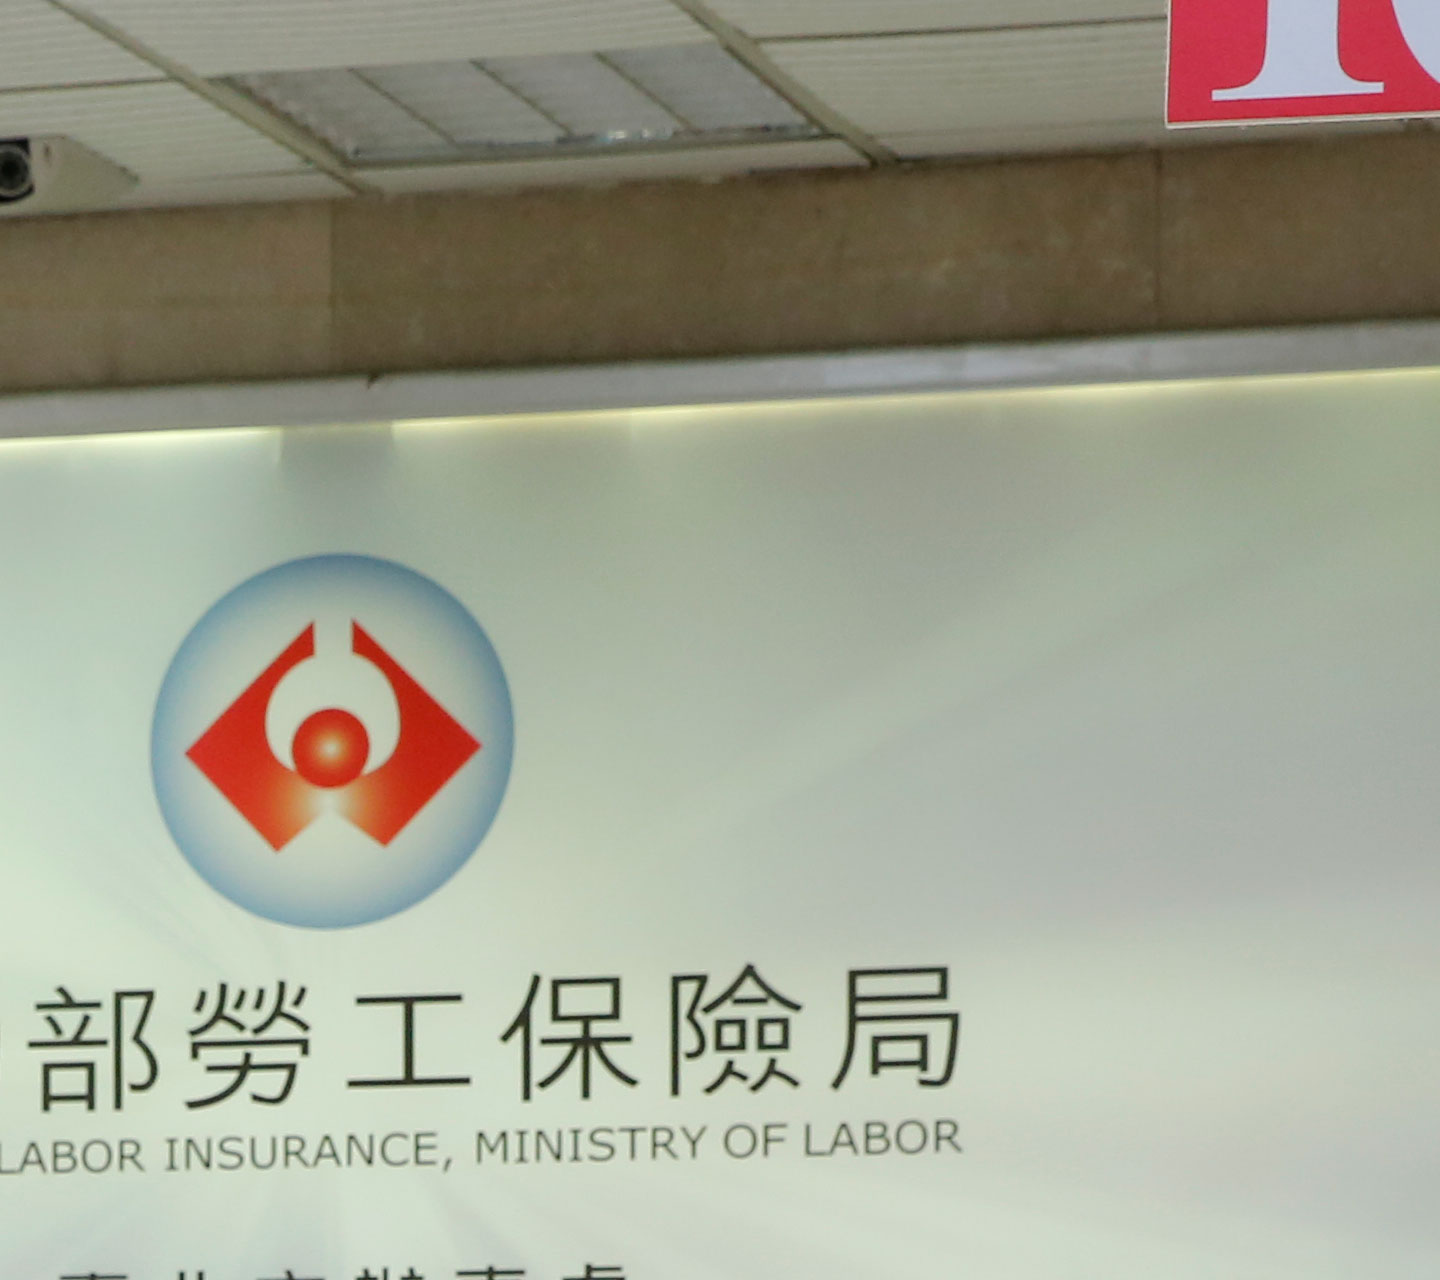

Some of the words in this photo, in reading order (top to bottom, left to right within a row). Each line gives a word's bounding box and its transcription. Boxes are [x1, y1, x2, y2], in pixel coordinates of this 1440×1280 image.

[163, 1130, 452, 1174] INSURANCE,
[475, 1126, 707, 1164] MINISTRY
[723, 1123, 788, 1159] OF
[803, 1118, 964, 1158] LABOR
